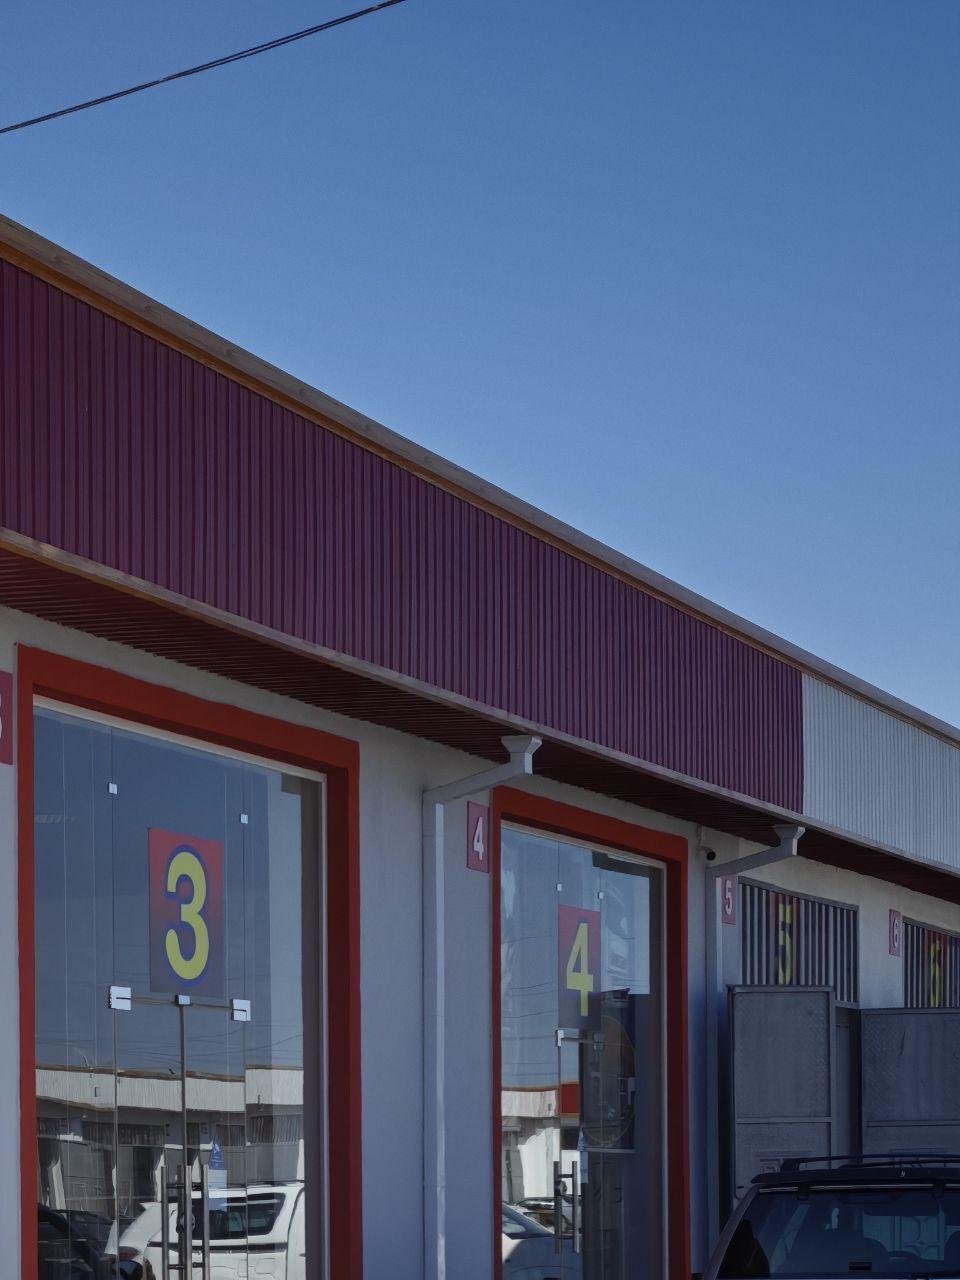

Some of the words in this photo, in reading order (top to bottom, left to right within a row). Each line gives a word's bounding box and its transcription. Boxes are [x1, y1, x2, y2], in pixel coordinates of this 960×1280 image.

[472, 816, 484, 861] 4
[165, 851, 209, 980] 3
[724, 879, 733, 916] 5
[892, 919, 900, 949] 6
[566, 922, 594, 1016] 4
